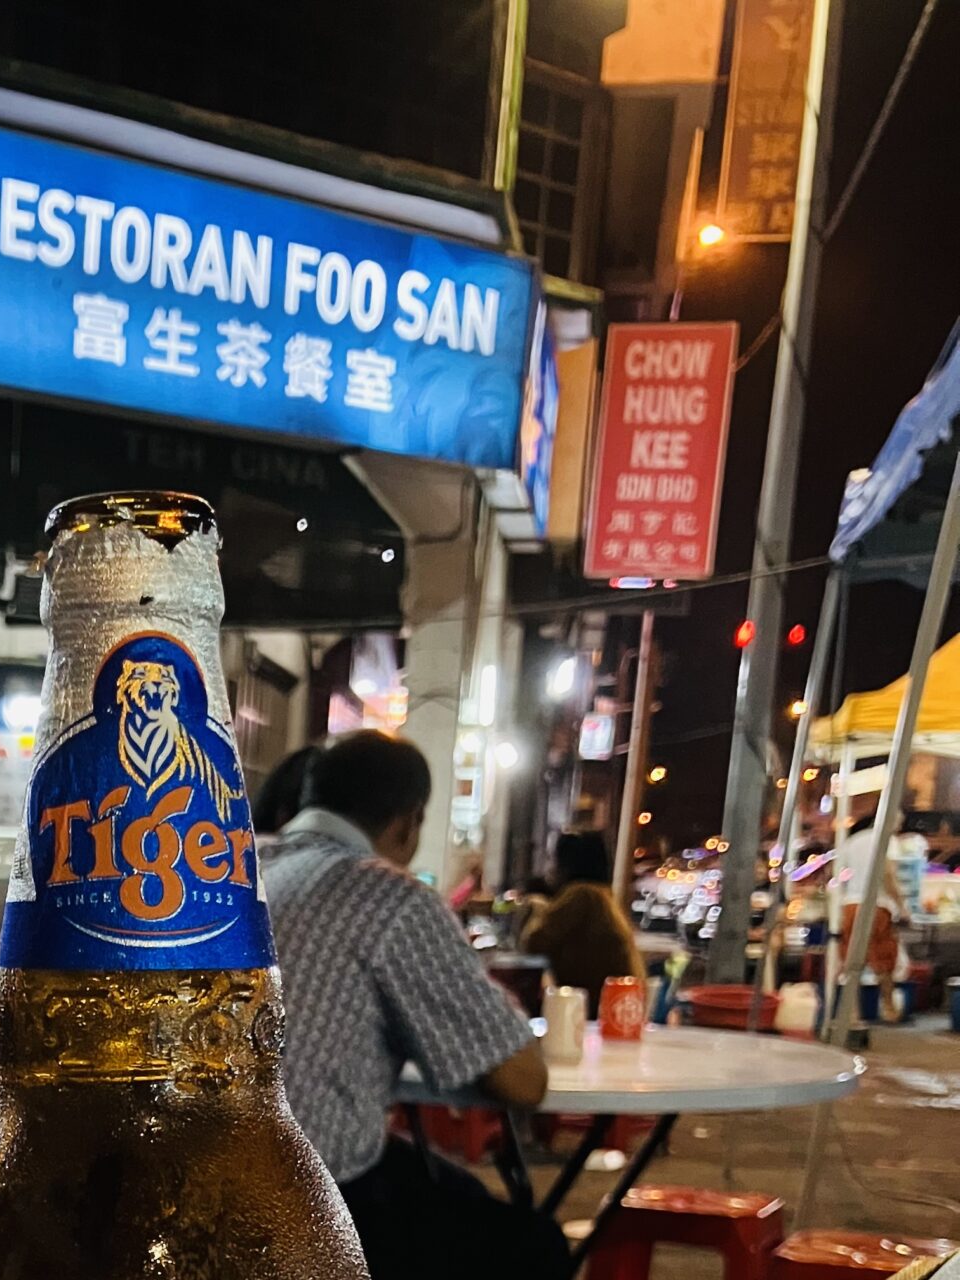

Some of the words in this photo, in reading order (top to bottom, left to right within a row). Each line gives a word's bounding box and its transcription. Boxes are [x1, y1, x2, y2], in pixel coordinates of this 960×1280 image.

[283, 241, 388, 334] FOO
[392, 269, 501, 357] SAN
[71, 290, 398, 414] 富生茶餐室
[623, 339, 715, 379] CHOW
[622, 385, 708, 425] HUNG
[630, 430, 691, 470] KEE
[39, 784, 254, 923] Tiger
[56, 891, 113, 909] SINCE
[191, 889, 235, 907] 1932
